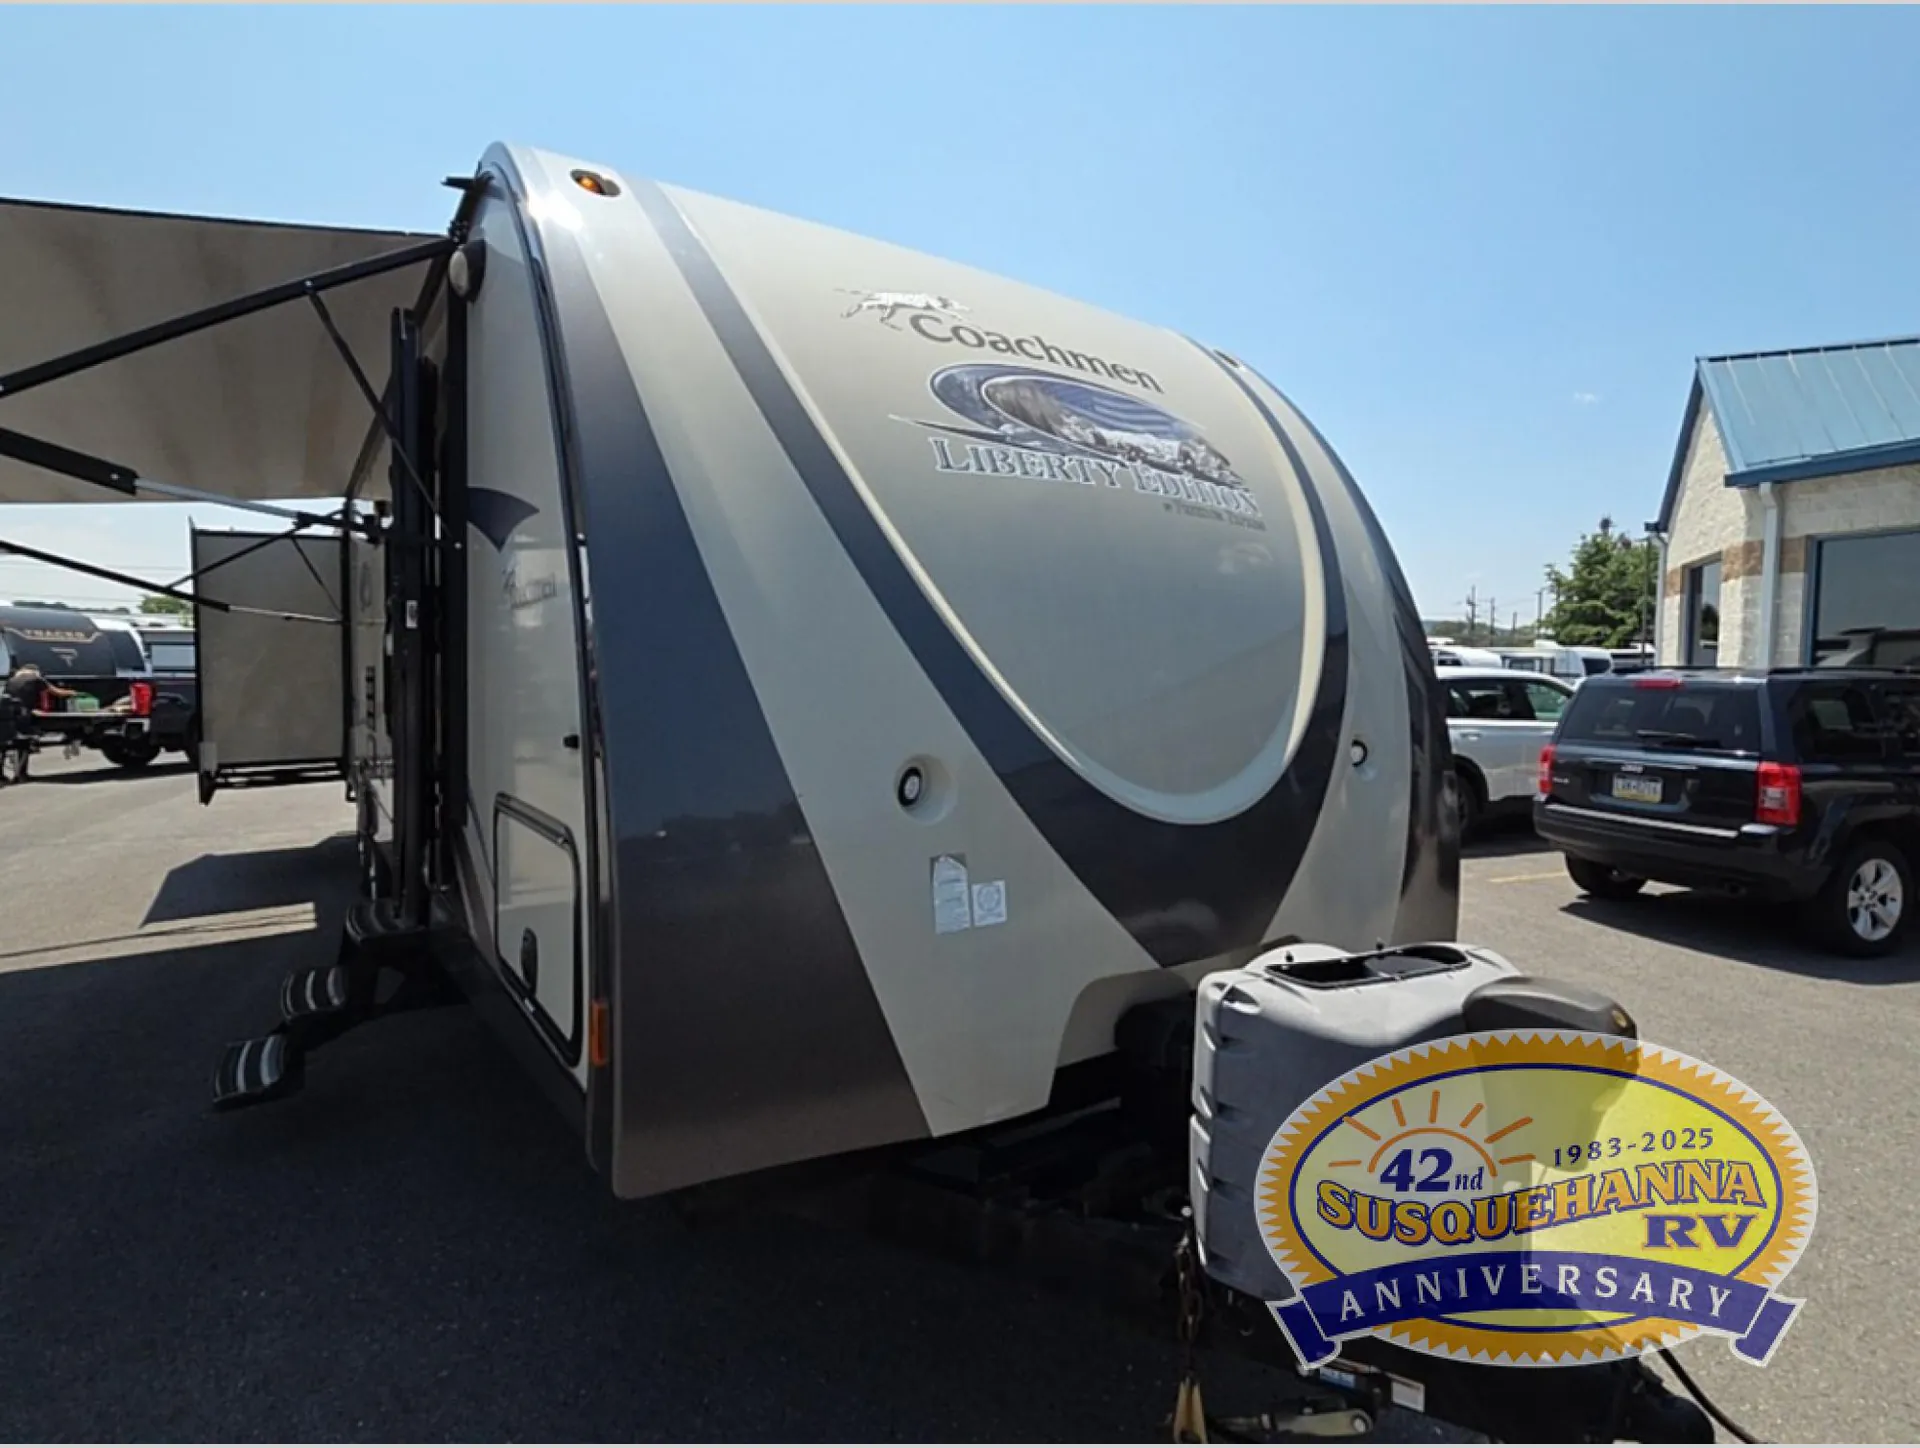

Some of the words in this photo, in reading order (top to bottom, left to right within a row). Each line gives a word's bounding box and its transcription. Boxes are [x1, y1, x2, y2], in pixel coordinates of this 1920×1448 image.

[910, 313, 1164, 394] Coachmen
[929, 437, 1121, 488] LIBERTY
[1129, 462, 1263, 518] EDITION
